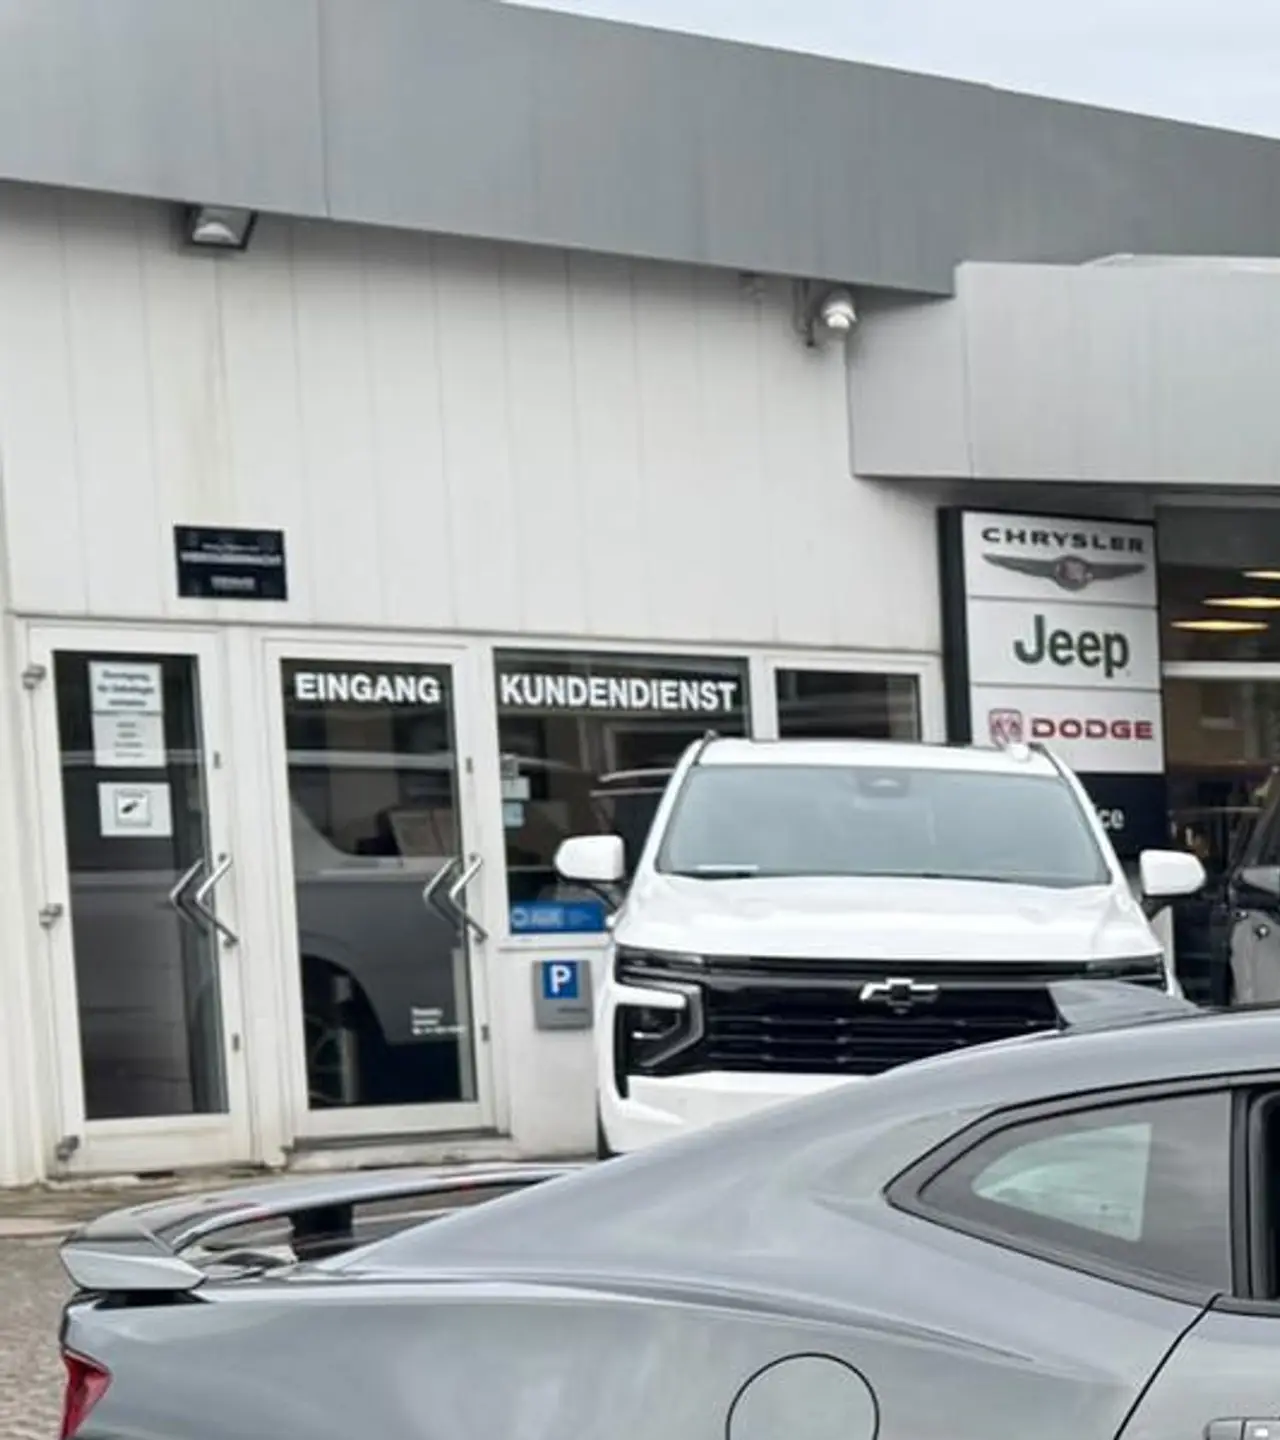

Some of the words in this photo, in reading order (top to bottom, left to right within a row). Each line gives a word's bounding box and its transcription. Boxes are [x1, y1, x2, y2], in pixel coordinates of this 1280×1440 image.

[982, 527, 1144, 553] CHRYSLER
[1014, 614, 1129, 678] Jeep
[295, 672, 442, 704] EINGANG
[501, 673, 737, 712] KUNDENDIENST
[1031, 717, 1153, 740] DODGE
[550, 964, 571, 994] P
